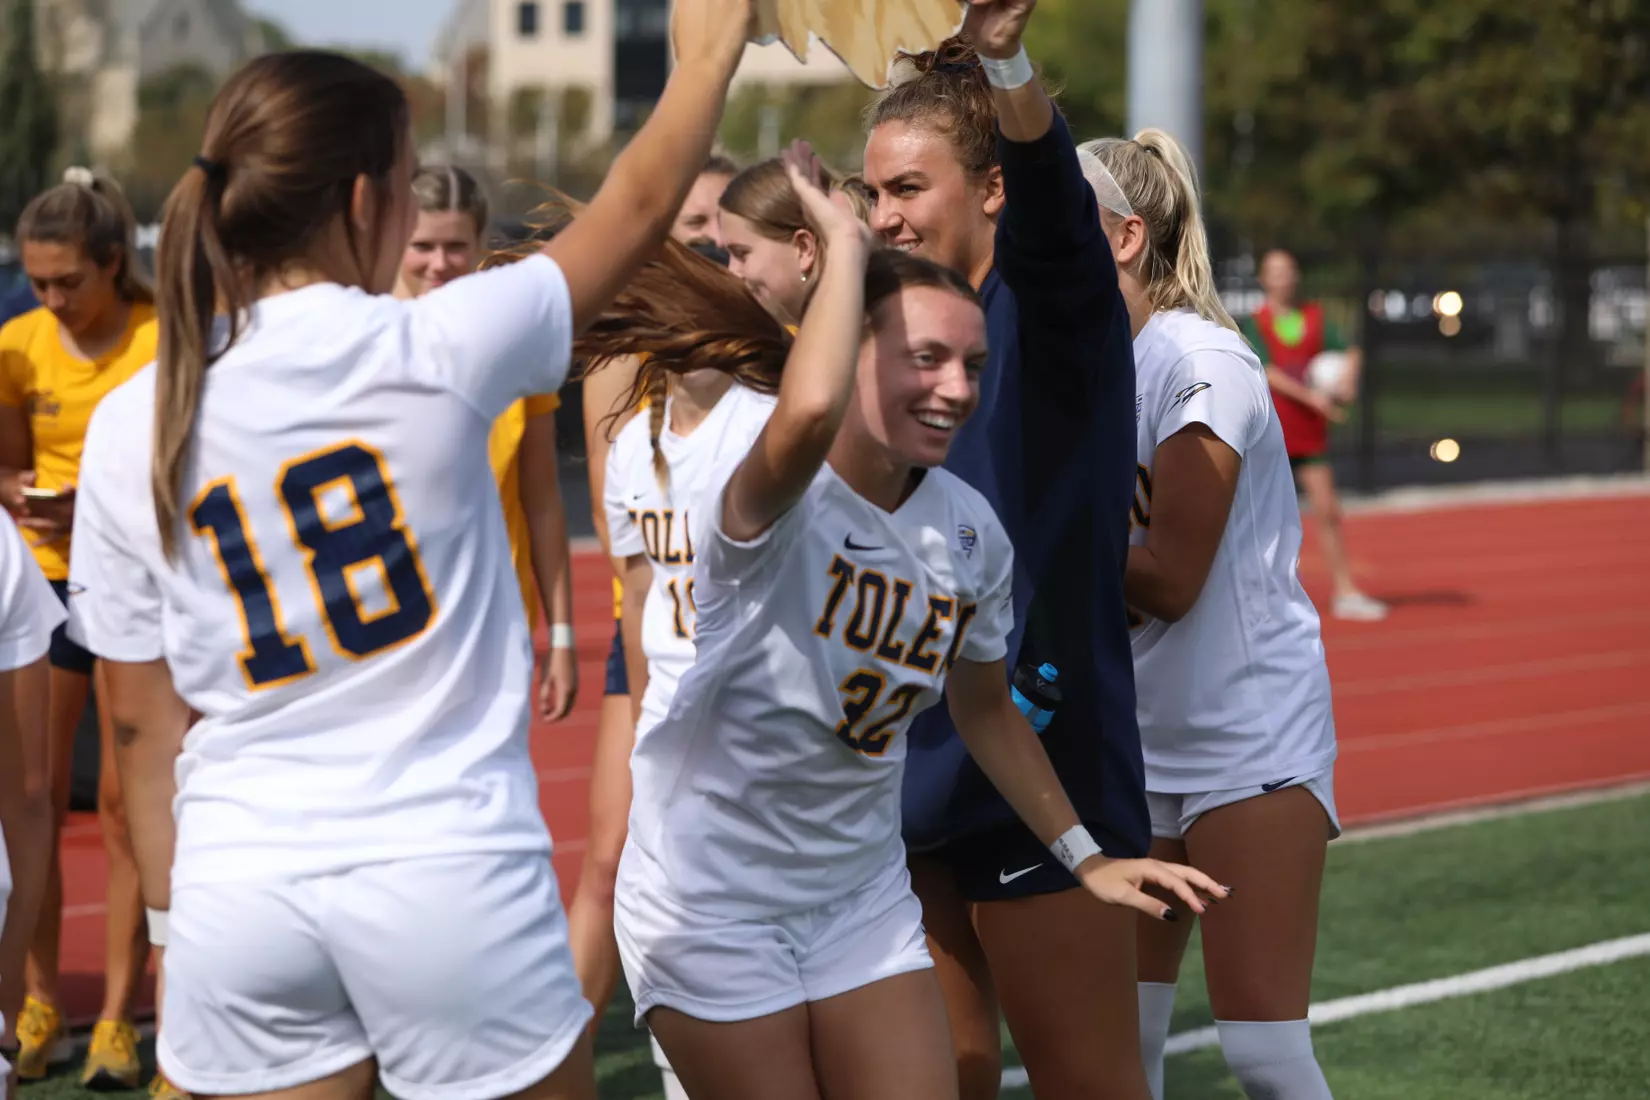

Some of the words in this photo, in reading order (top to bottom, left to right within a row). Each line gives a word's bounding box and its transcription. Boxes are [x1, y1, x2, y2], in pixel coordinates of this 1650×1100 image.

[186, 437, 440, 692] 18
[668, 577, 697, 640] 1
[835, 668, 928, 757] 22
